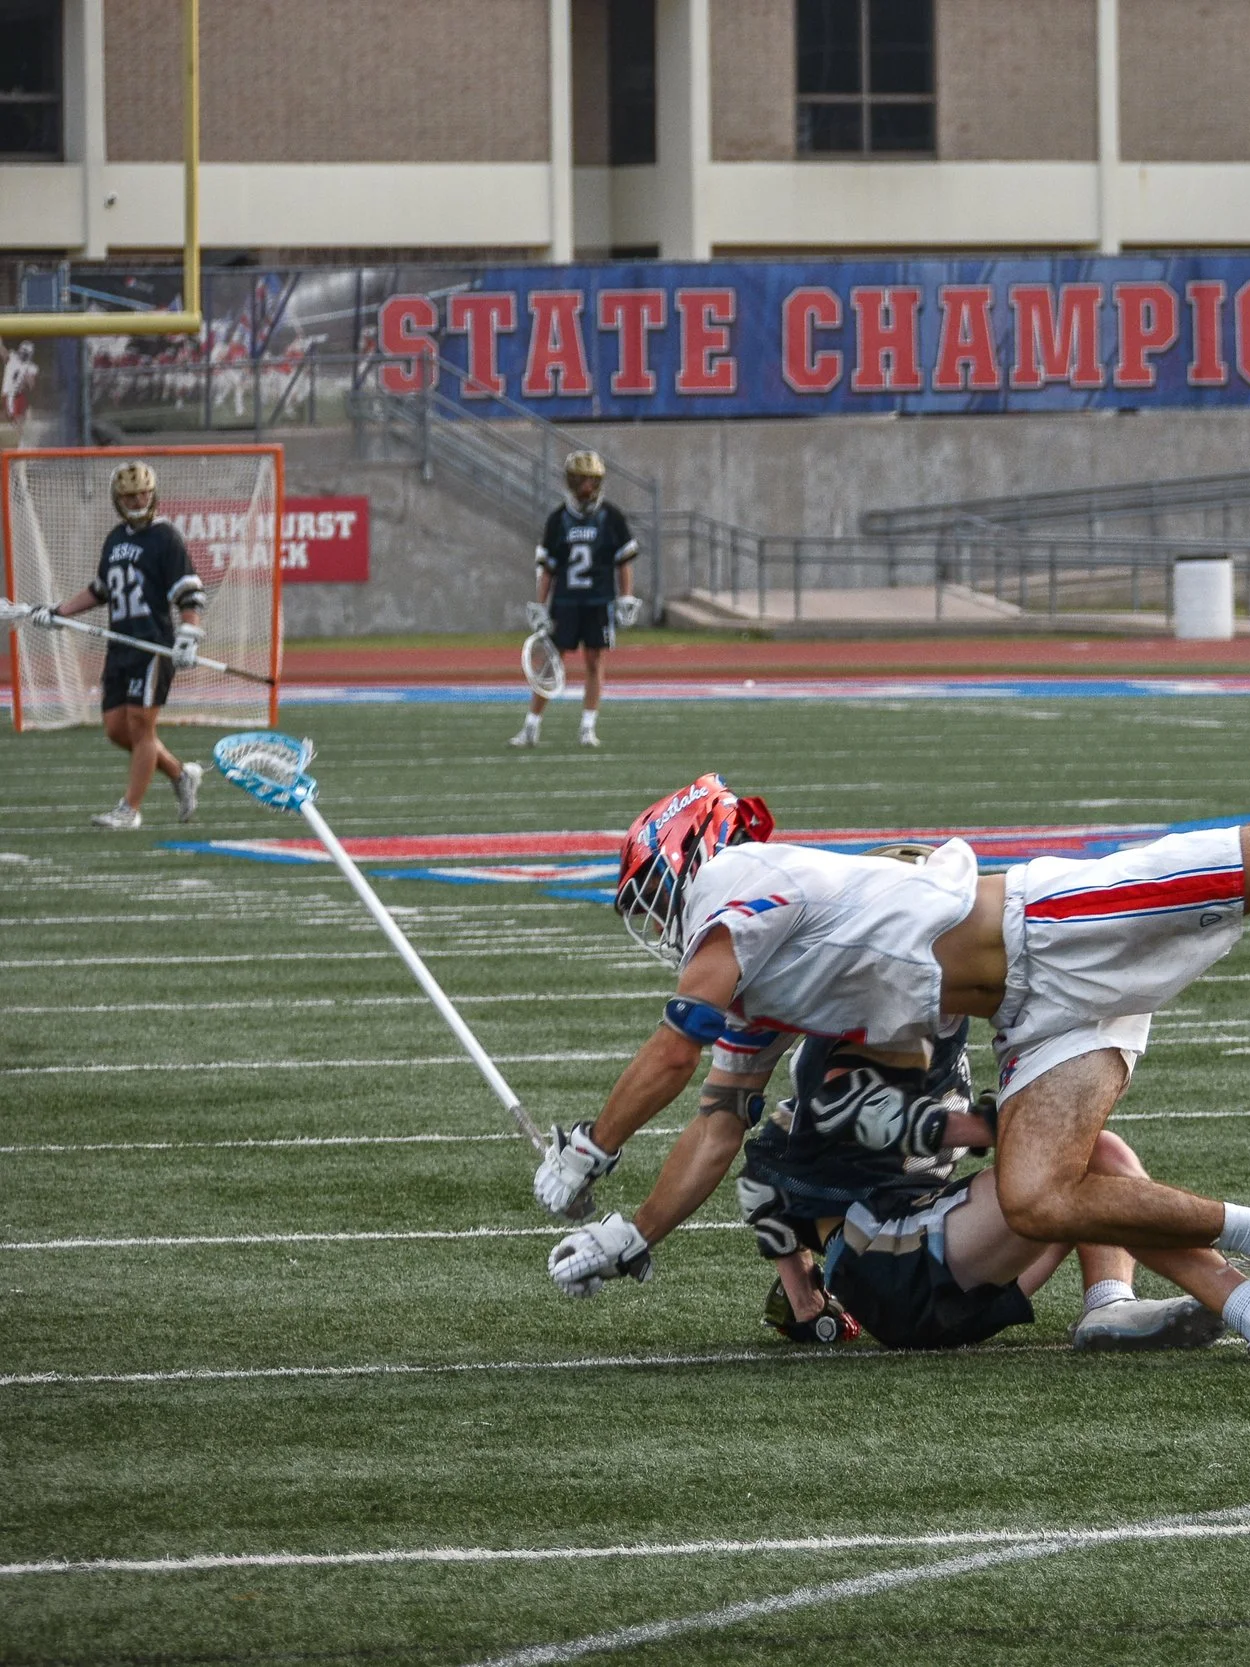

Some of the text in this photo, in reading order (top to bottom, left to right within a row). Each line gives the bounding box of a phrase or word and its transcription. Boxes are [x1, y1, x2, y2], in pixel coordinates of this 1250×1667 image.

[378, 287, 738, 399] STATE
[255, 511, 357, 540] HURST
[106, 563, 152, 622] 32
[567, 544, 593, 589] 2
[637, 784, 709, 847] Westlake
